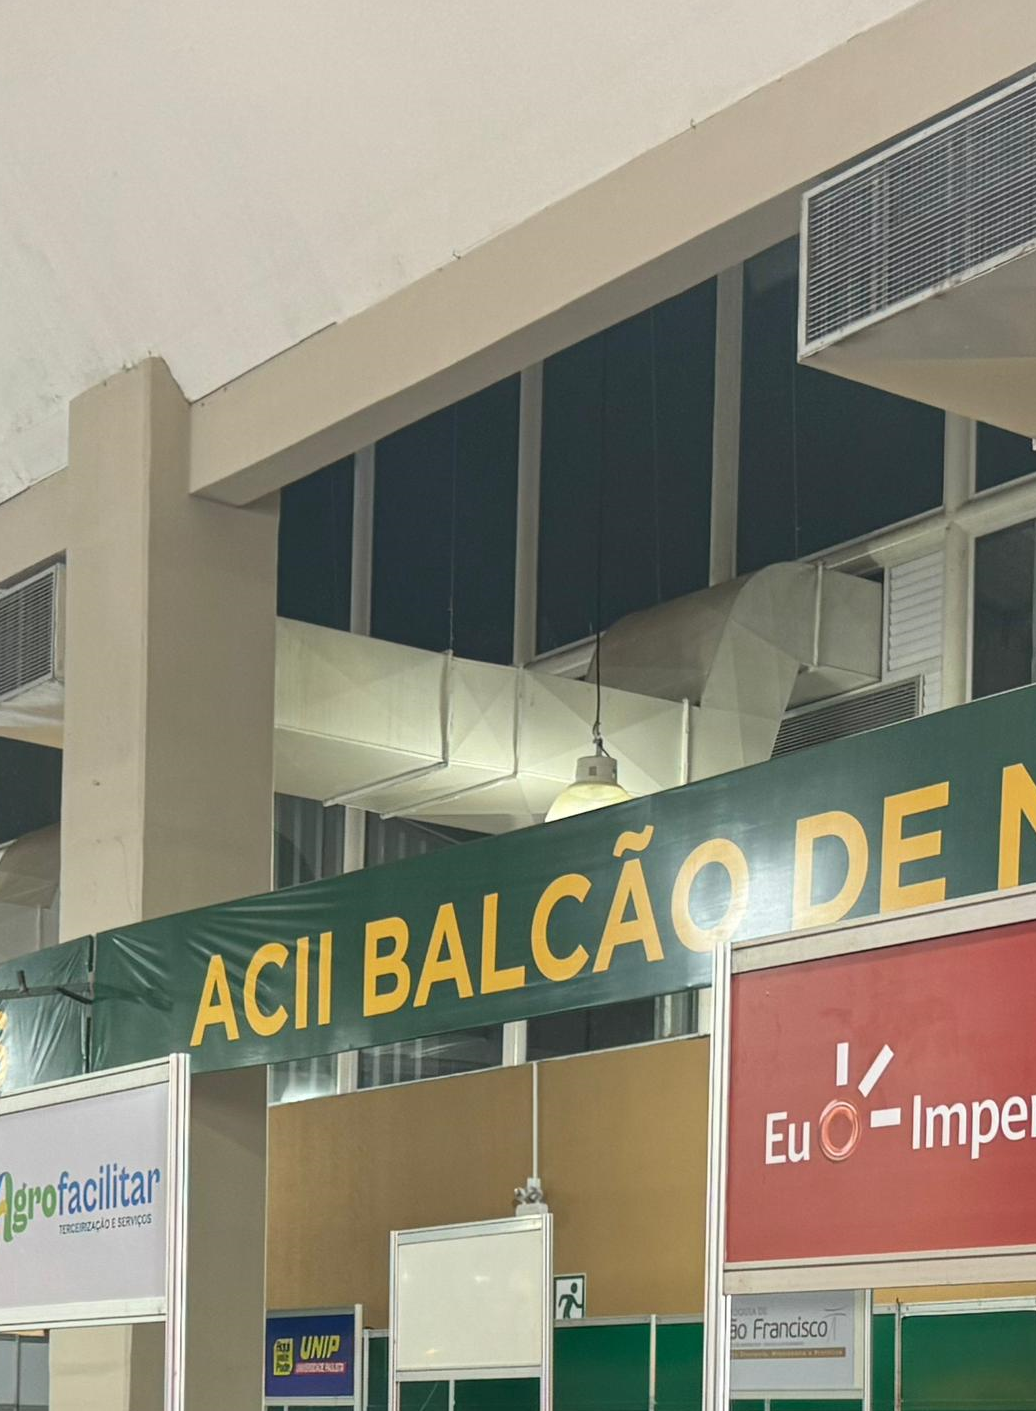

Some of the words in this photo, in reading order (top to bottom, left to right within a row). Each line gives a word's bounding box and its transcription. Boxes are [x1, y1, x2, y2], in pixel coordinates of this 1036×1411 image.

[190, 929, 333, 1046] ACII
[362, 834, 749, 1017] BALCÃO
[792, 781, 950, 931] DE
[764, 1112, 811, 1165] Eu
[300, 1334, 341, 1360] UNIP
[730, 1318, 748, 1340] ão
[753, 1316, 829, 1340] Francisco
